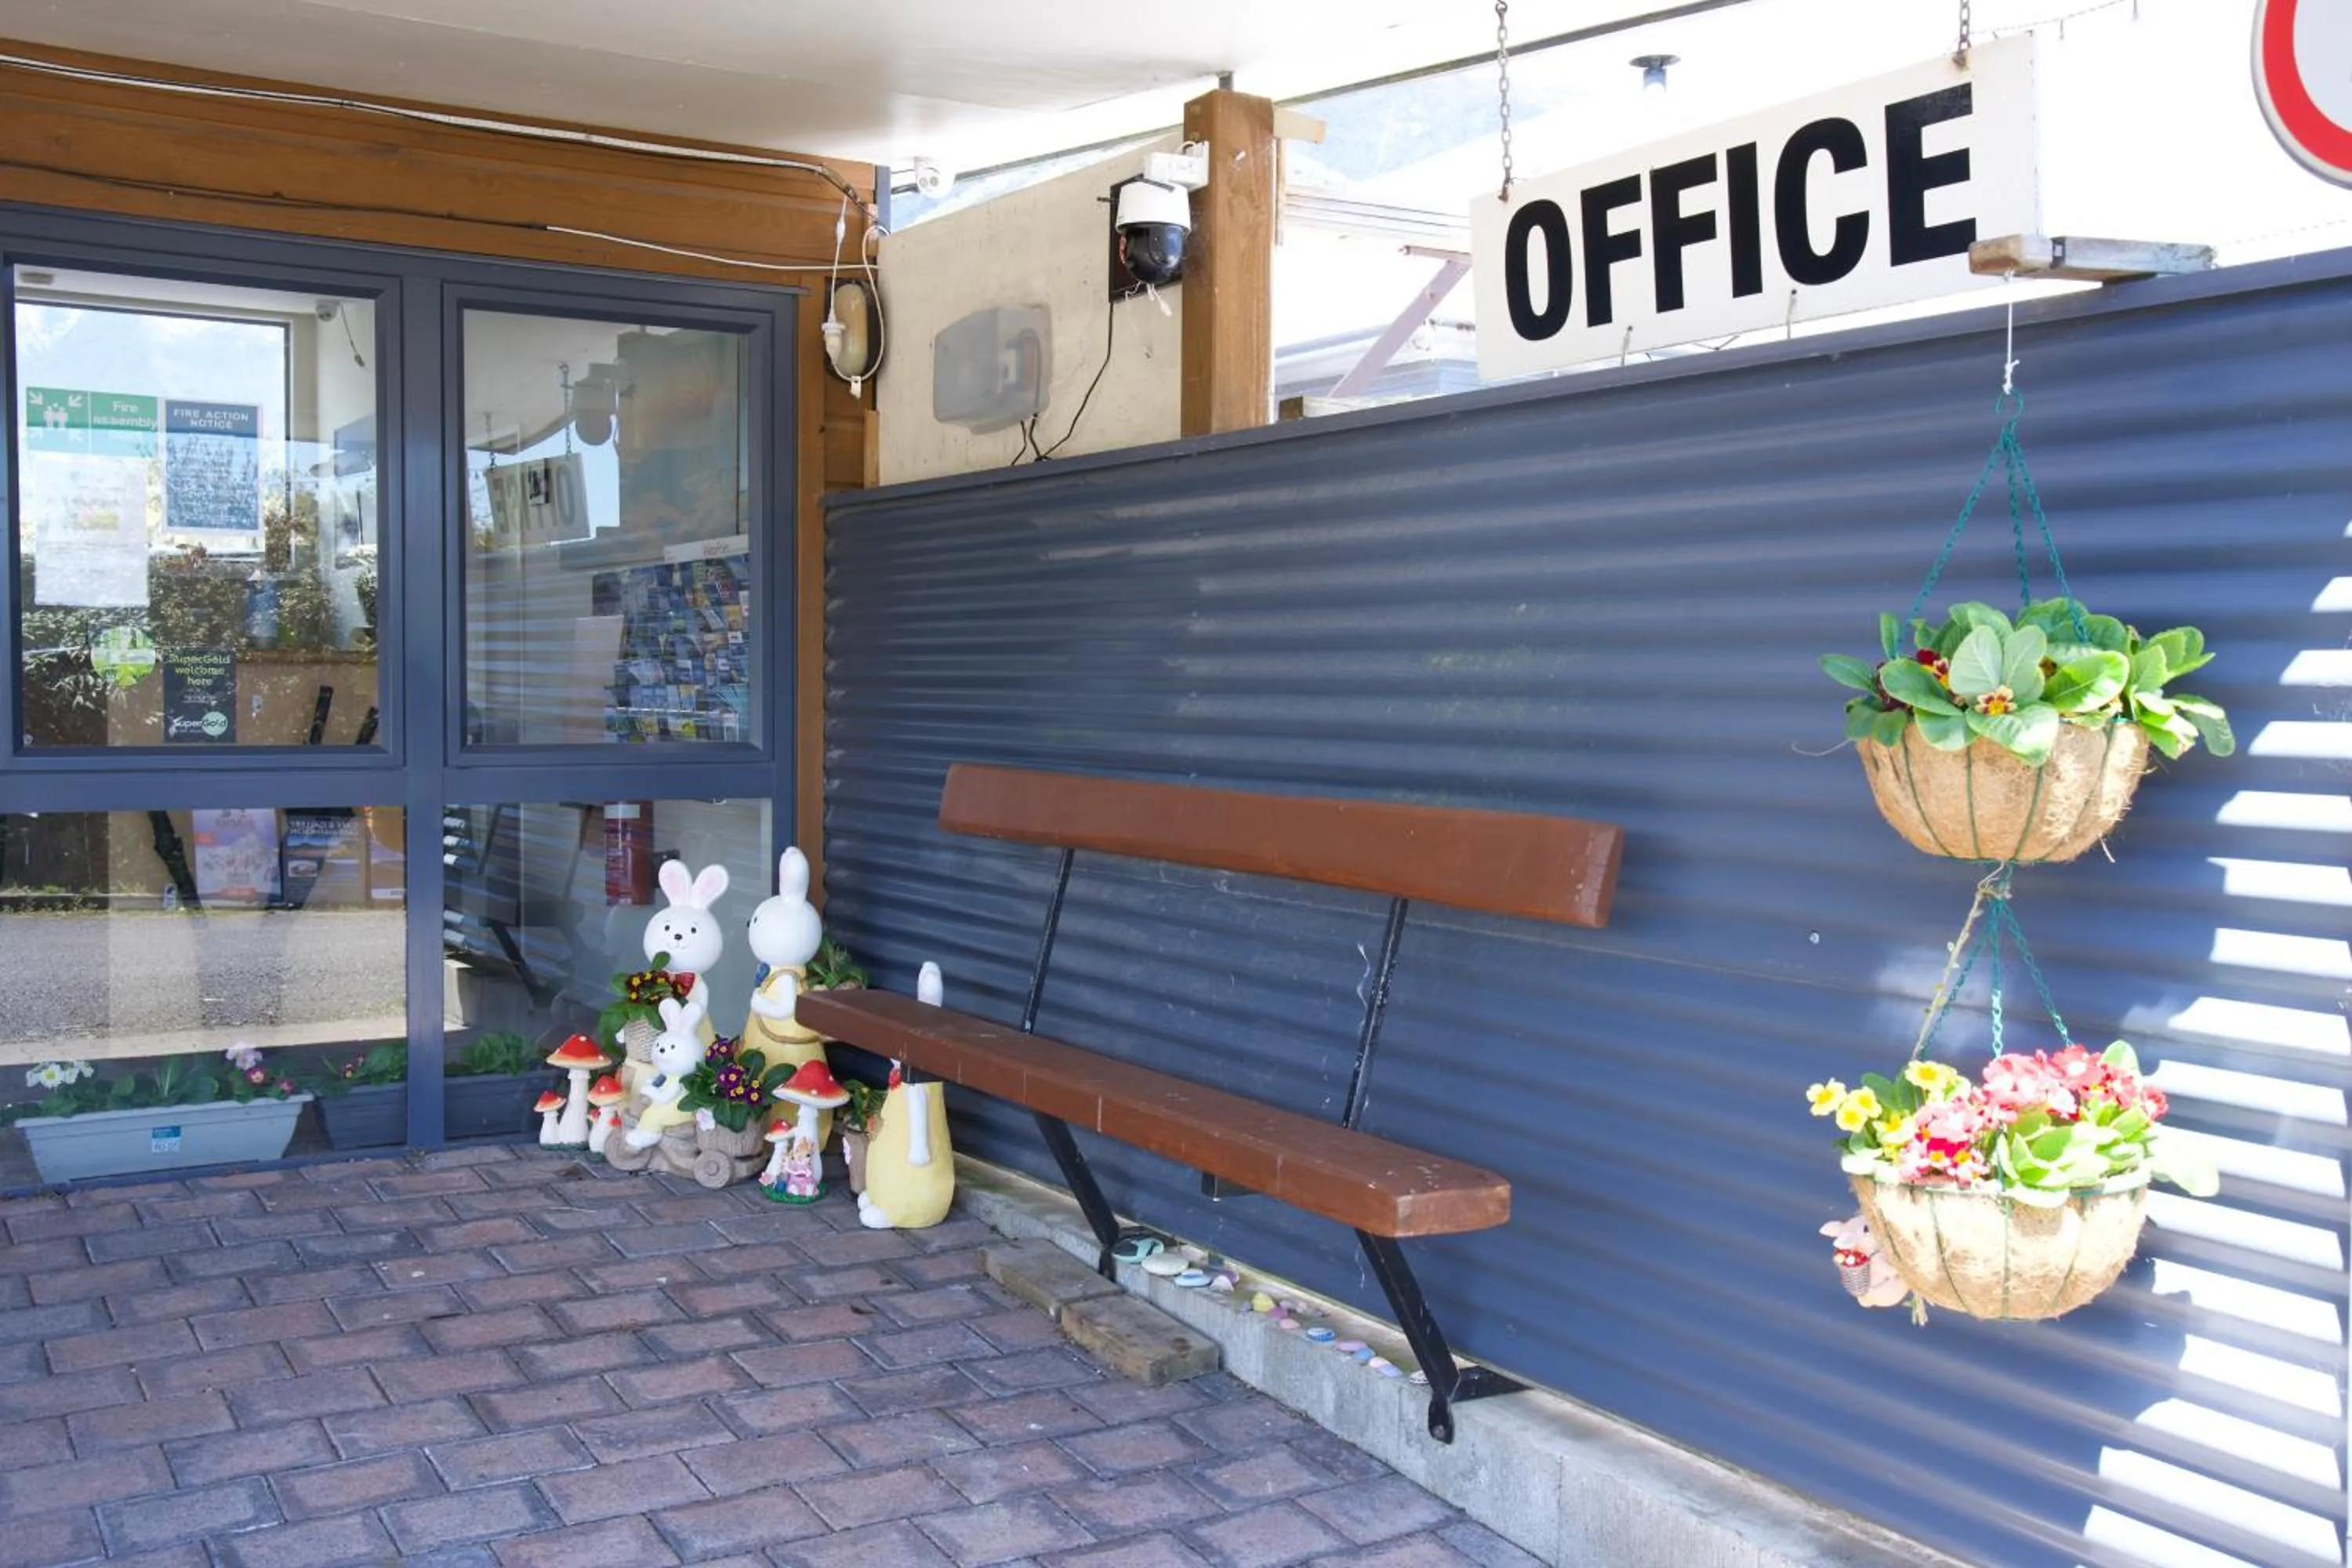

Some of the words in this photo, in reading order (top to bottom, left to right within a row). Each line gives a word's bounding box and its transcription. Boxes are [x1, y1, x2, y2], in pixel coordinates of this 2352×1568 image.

[1504, 82, 1976, 341] OFFICE
[113, 401, 138, 413] Fire
[173, 408, 200, 418] FIRE
[205, 411, 249, 421] ACTION
[191, 419, 233, 429] NOTICE
[175, 666, 225, 675] welcome
[187, 675, 213, 686] here
